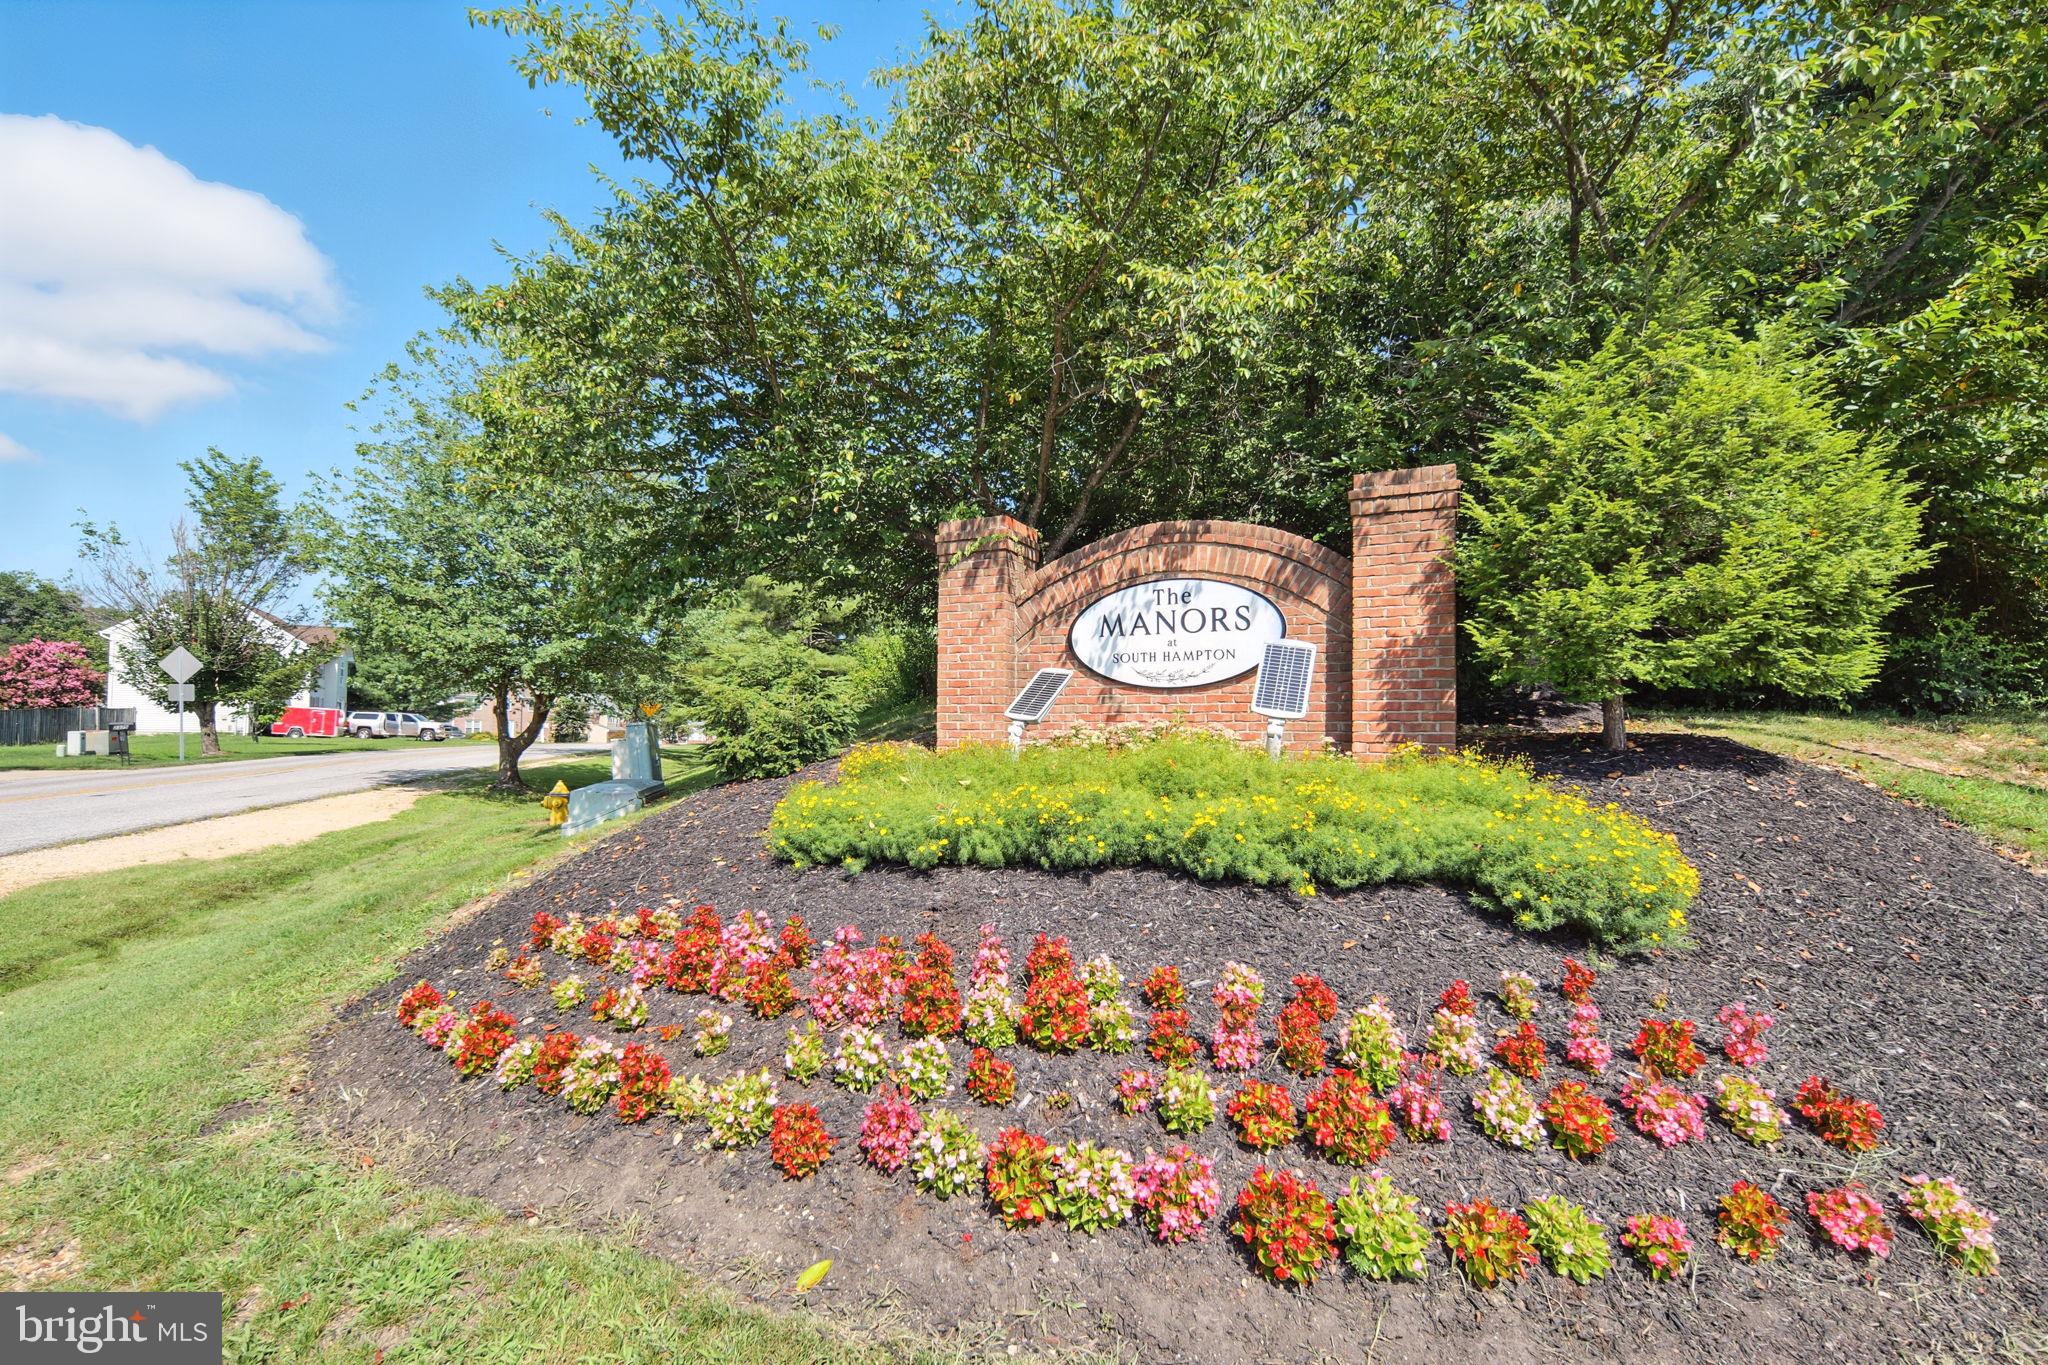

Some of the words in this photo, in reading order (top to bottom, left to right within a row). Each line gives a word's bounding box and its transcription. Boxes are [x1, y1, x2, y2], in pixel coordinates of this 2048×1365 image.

[1153, 588, 1192, 606] The
[1099, 605, 1251, 638] MANORS
[1167, 639, 1177, 647] at
[1112, 651, 1157, 664] SOUTH
[1163, 649, 1236, 662] HAMPTON
